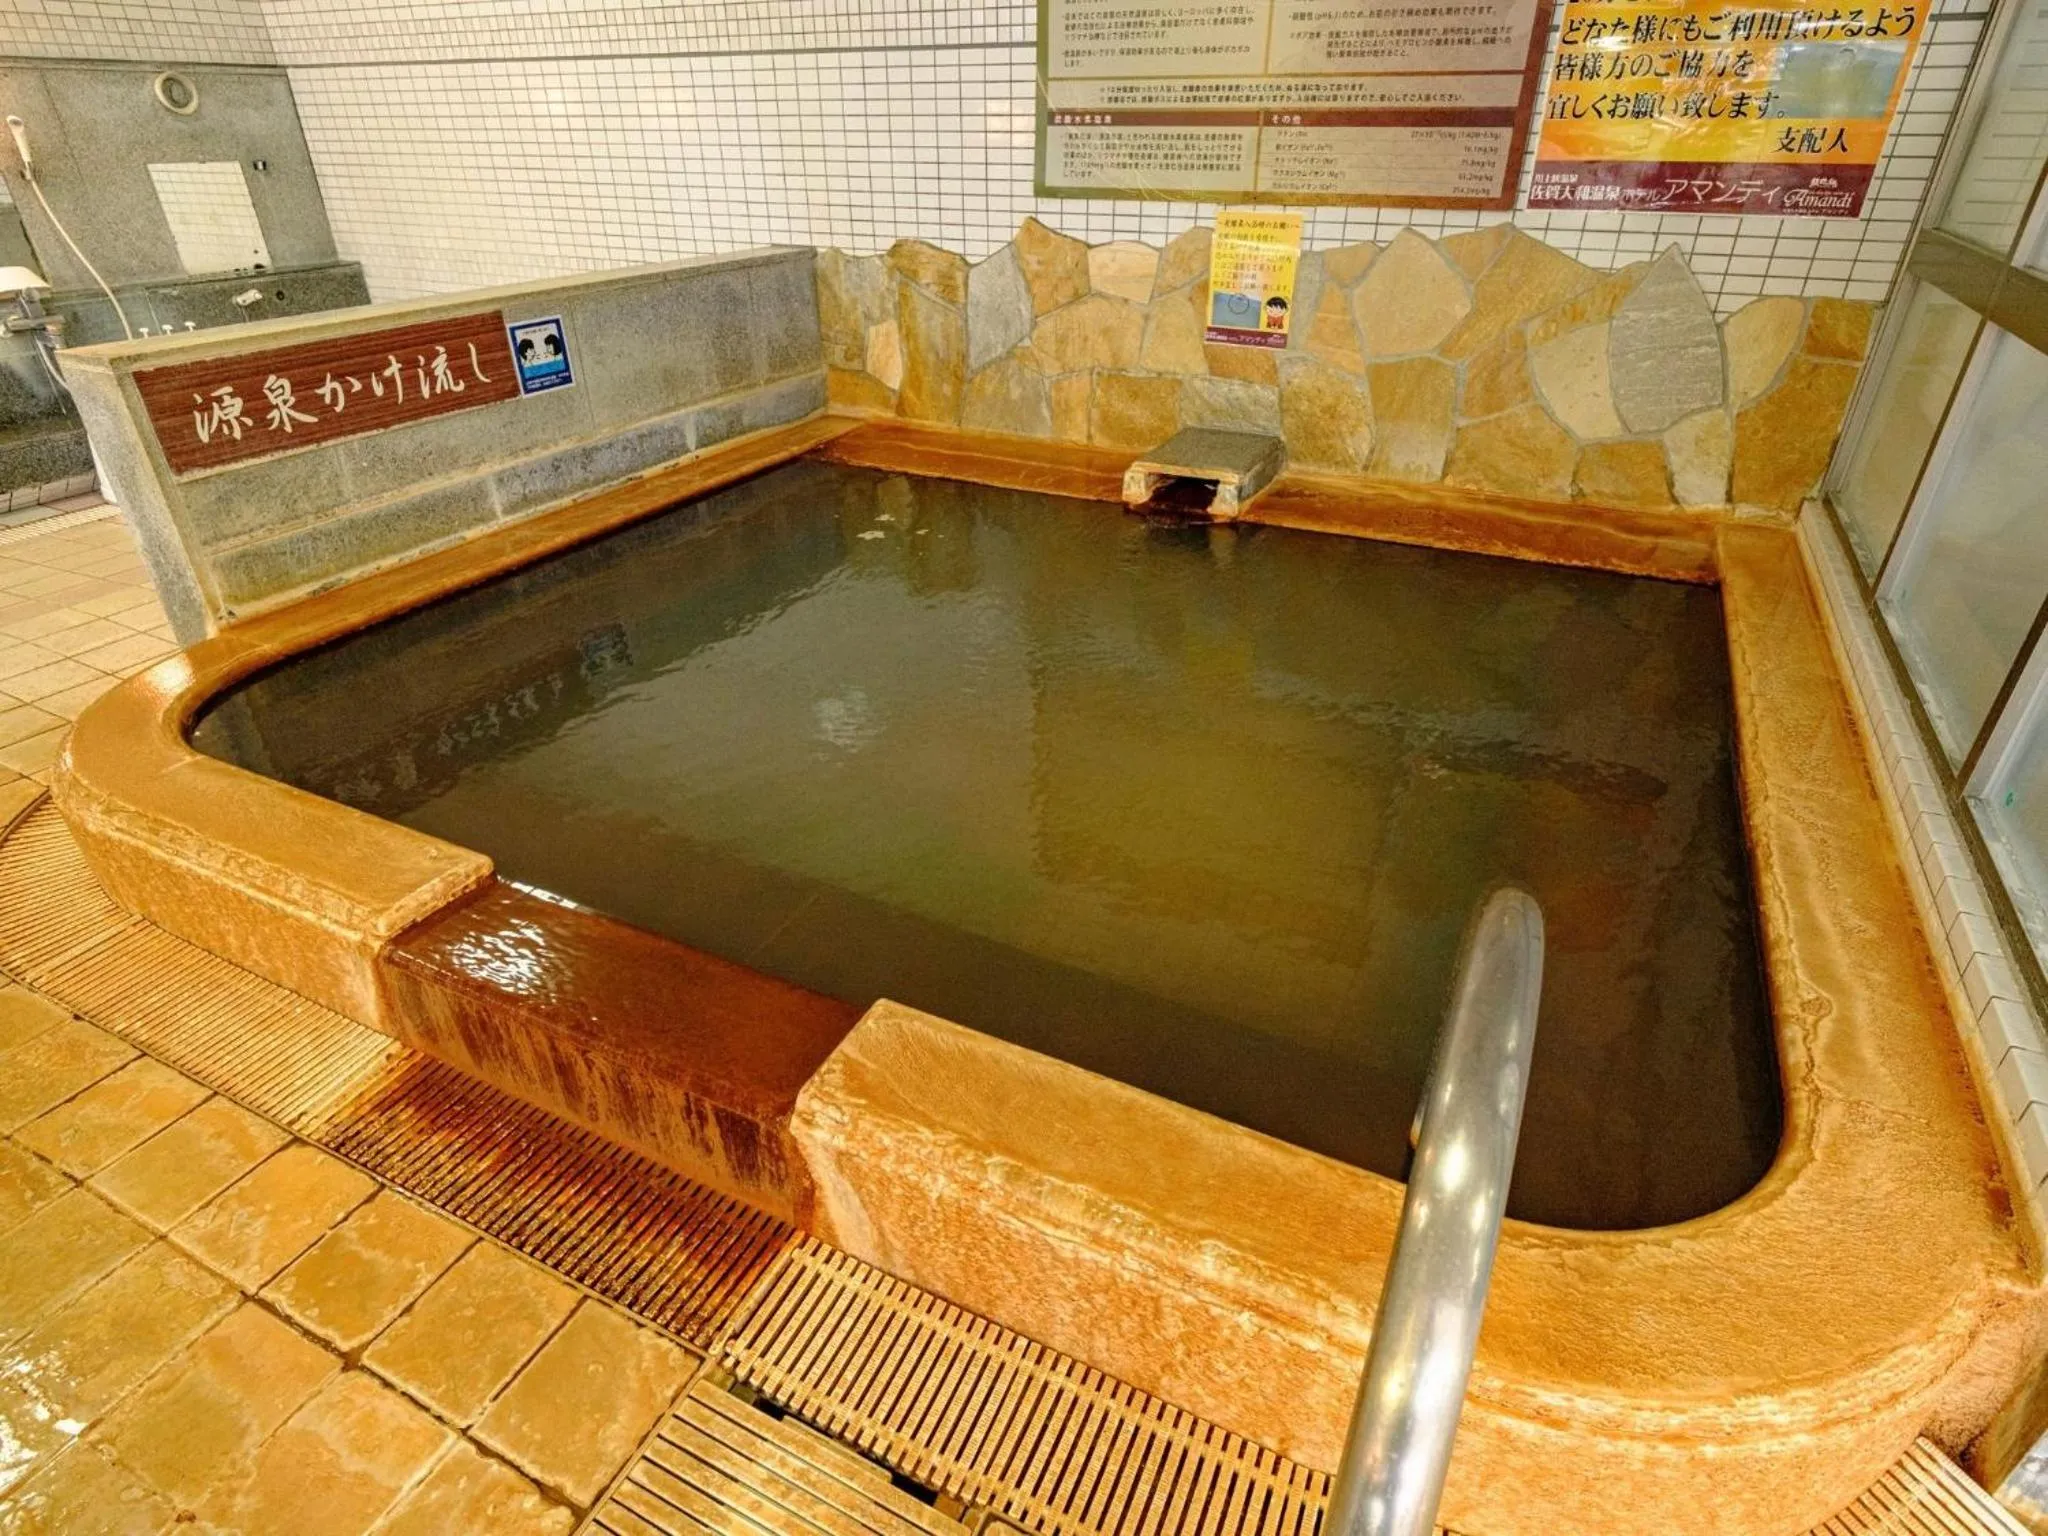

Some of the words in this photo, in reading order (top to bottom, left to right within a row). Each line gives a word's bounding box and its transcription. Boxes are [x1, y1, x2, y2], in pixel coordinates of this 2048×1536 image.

[1562, 6, 1917, 45] どなた様にもご利用頂けるよう
[1555, 48, 1755, 81] 皆様方のご協力を
[1548, 92, 1787, 120] 宜しくお願い致します。
[1775, 126, 1849, 154] 支配人
[193, 343, 491, 443] 源泉かけ流し
